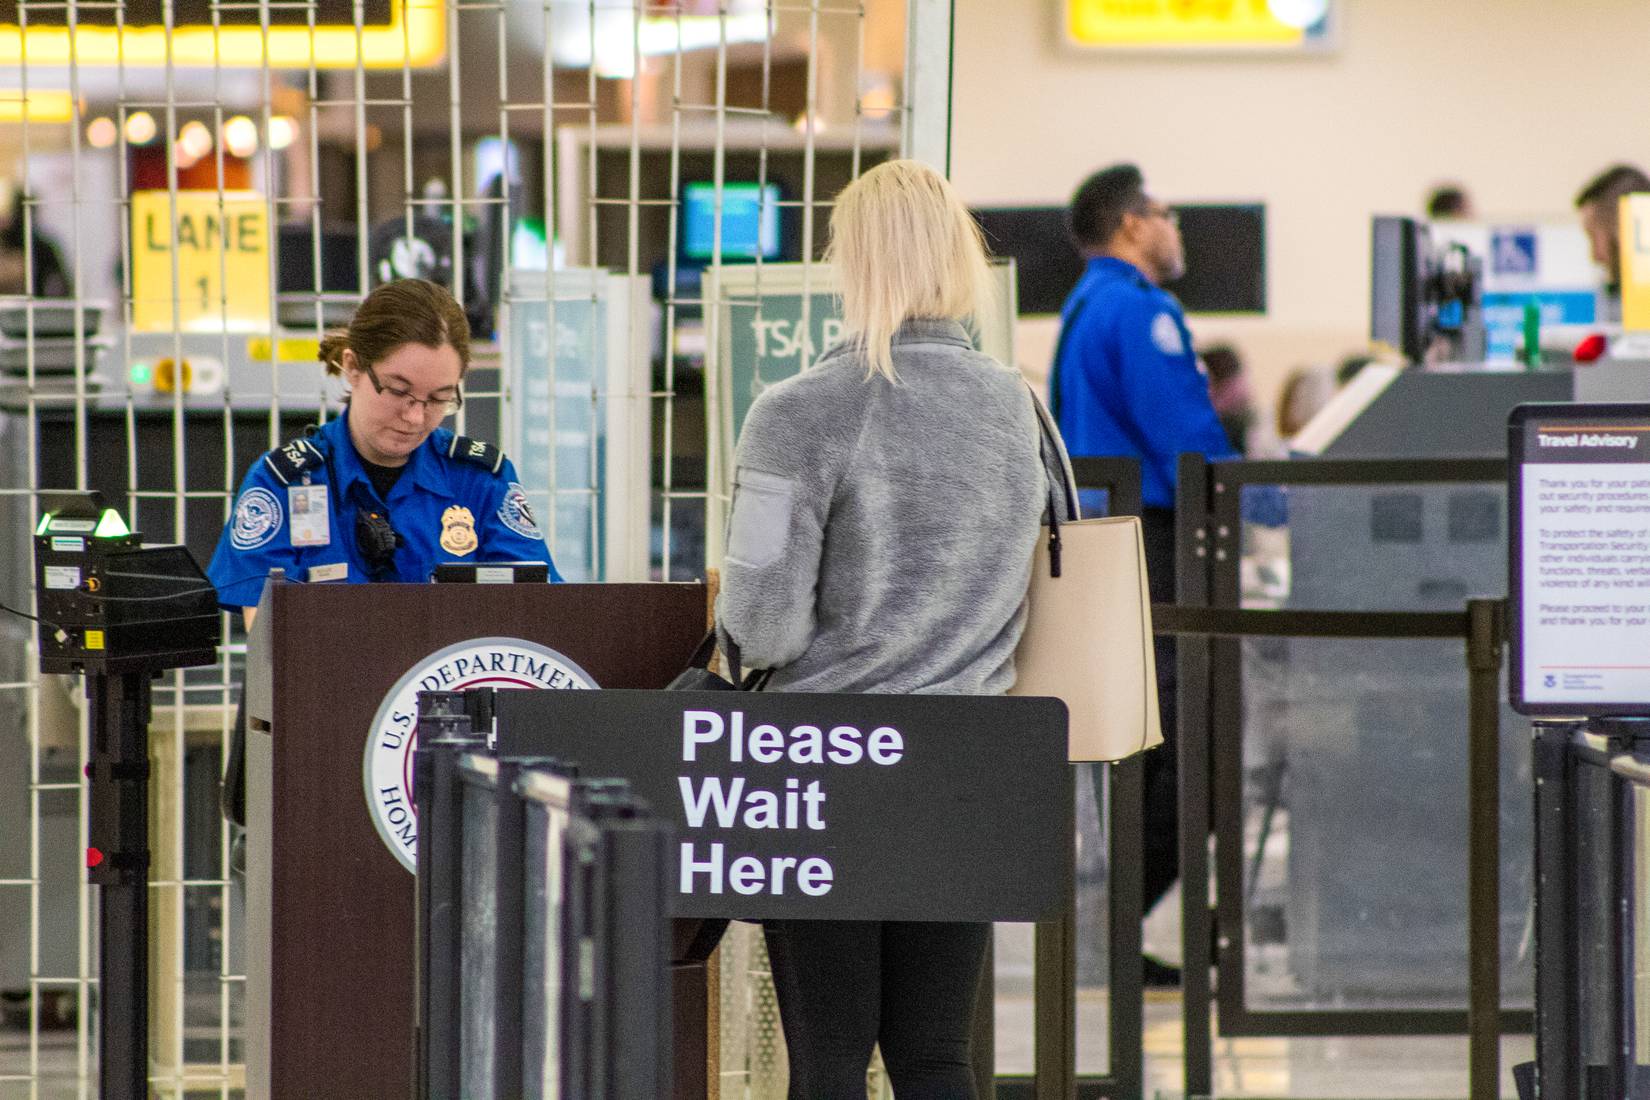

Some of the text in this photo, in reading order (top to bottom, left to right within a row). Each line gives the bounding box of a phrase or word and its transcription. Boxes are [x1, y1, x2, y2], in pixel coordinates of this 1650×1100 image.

[146, 213, 260, 252] LANE
[750, 318, 816, 357] TSA
[282, 442, 307, 468] TSA
[468, 440, 487, 457] TSA
[1538, 433, 1638, 449] Travel Advisory
[1571, 480, 1589, 490] you
[382, 711, 415, 750] U.S.
[682, 710, 904, 766] Please
[678, 776, 826, 831] Wait
[680, 842, 834, 897] Here
